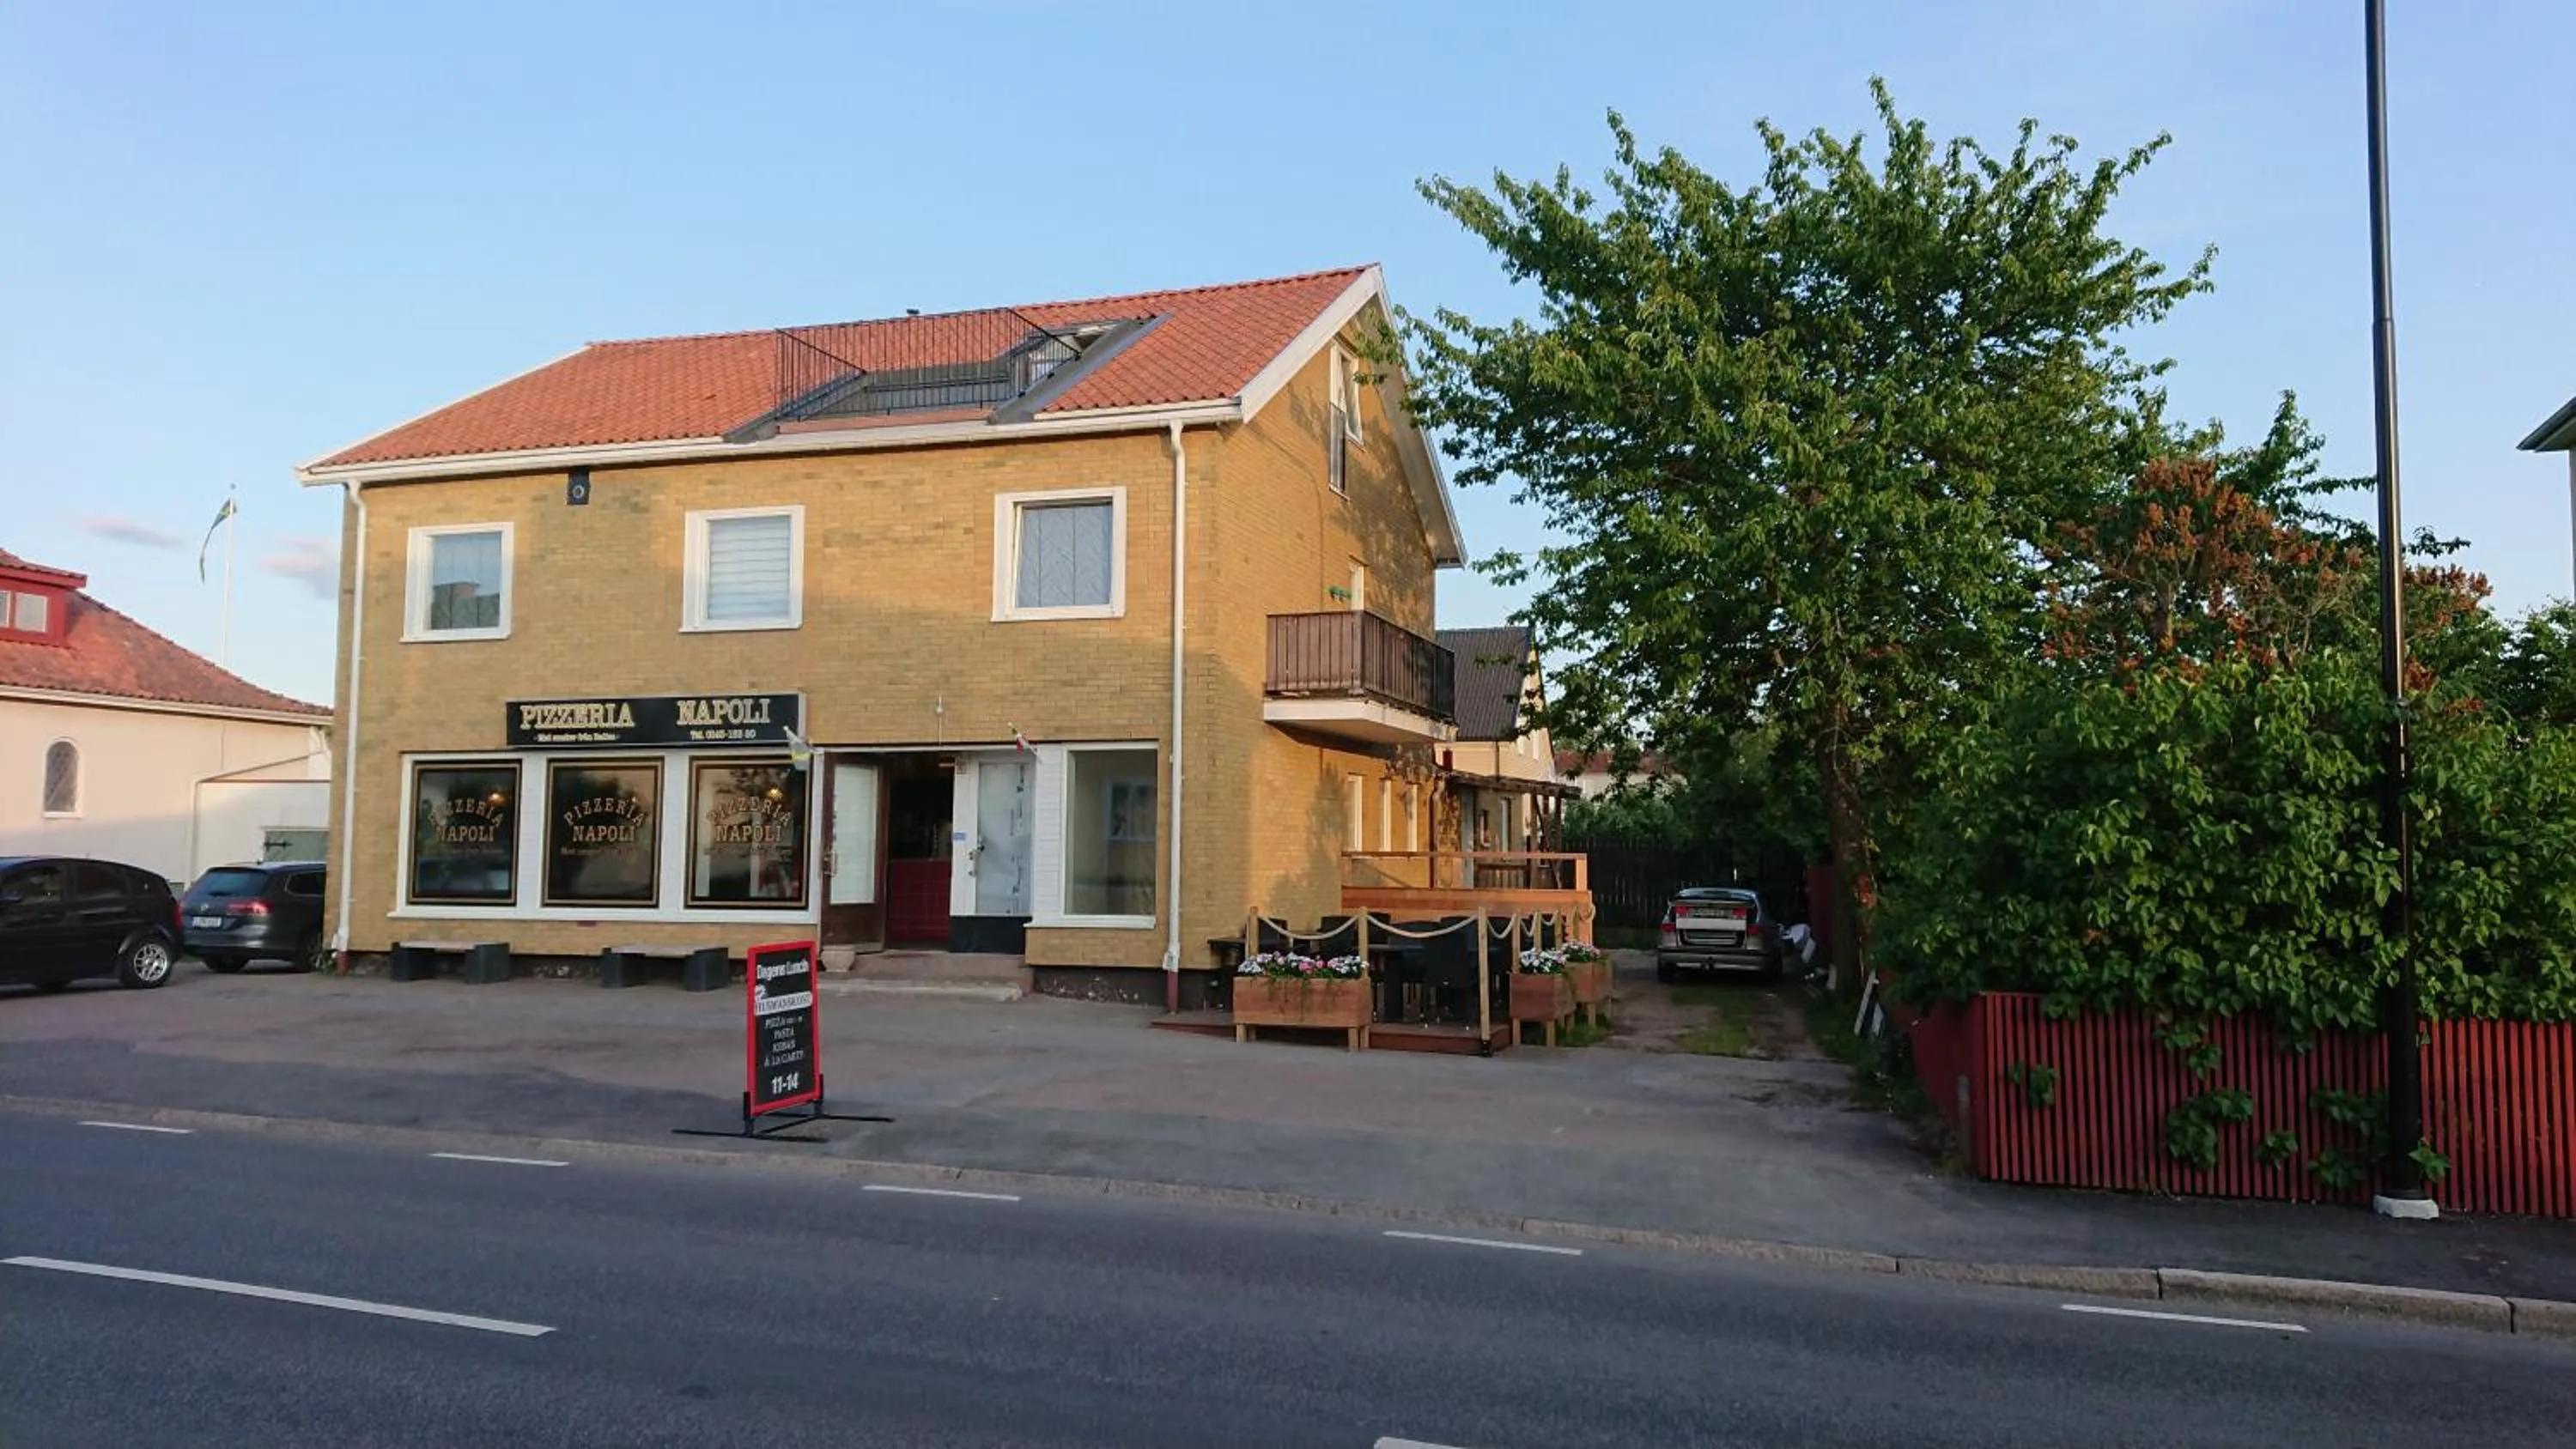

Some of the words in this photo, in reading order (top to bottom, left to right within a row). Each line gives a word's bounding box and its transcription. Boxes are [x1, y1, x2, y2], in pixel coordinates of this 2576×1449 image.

[519, 702, 635, 730] PIZZERIA
[677, 698, 771, 725] NAPOLI
[563, 797, 646, 827] PIZZERIA
[436, 825, 495, 841] NAPOLI
[573, 825, 635, 842] NAPOLI
[715, 825, 781, 842] NAPOLI
[774, 1026, 794, 1040] PASTA
[772, 1072, 799, 1094] 11-14
